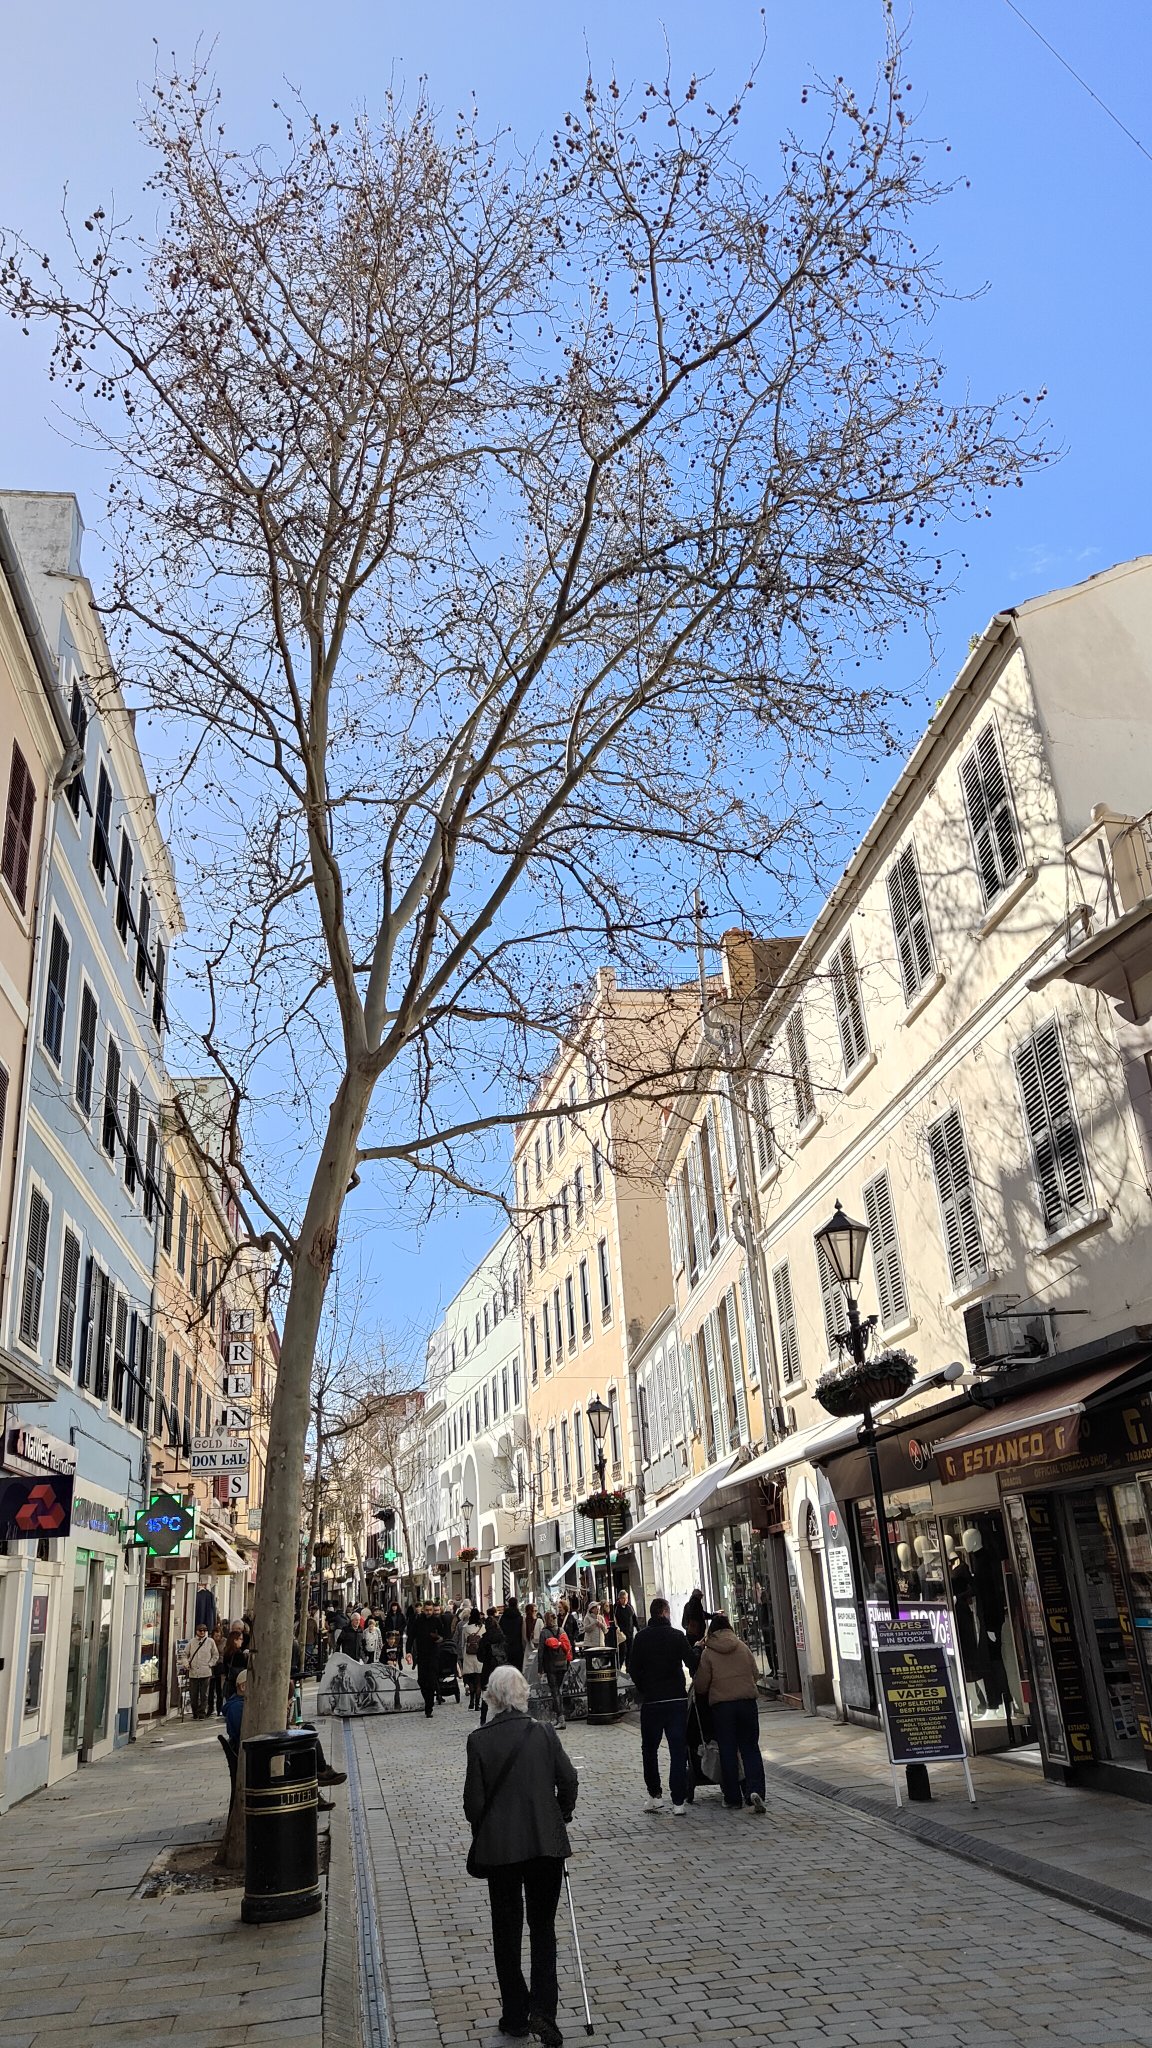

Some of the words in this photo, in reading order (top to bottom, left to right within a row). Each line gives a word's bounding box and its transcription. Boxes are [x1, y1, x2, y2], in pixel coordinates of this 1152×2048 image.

[24, 1432, 50, 1467] NatWest
[194, 1439, 222, 1449] GOLD
[964, 1433, 1043, 1473] ESTANCO
[192, 1454, 217, 1467] DON
[221, 1453, 246, 1466] LAL
[1034, 1466, 1059, 1478] OFFICIAL
[1061, 1459, 1089, 1473] TOBACCO
[1091, 1454, 1108, 1466] SHOP
[885, 1621, 921, 1630] VAPES
[890, 1664, 938, 1676] TABACOS
[896, 1688, 939, 1699] VAPES
[908, 1699, 943, 1707] SELECTION
[280, 1789, 313, 1806] LITTER
